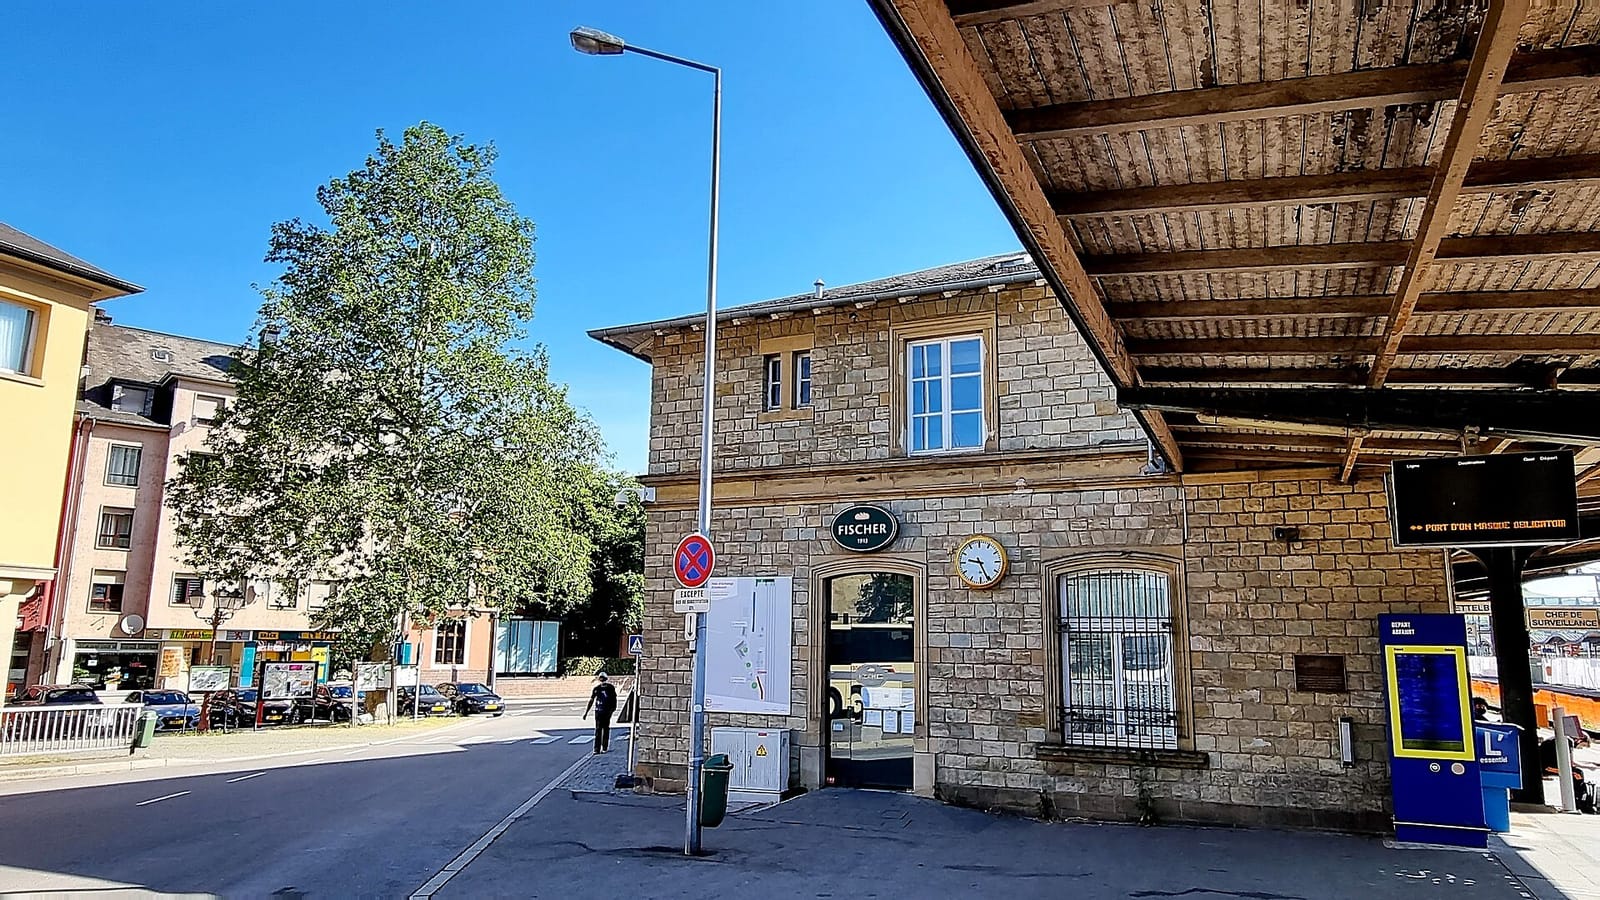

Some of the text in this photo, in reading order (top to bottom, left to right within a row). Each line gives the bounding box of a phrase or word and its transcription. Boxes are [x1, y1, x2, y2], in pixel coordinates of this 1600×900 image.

[838, 523, 887, 536] FISCHER
[1425, 523, 1449, 532] PORT
[1474, 521, 1511, 530] MASQUE
[1532, 619, 1597, 627] SURVEILLANCE
